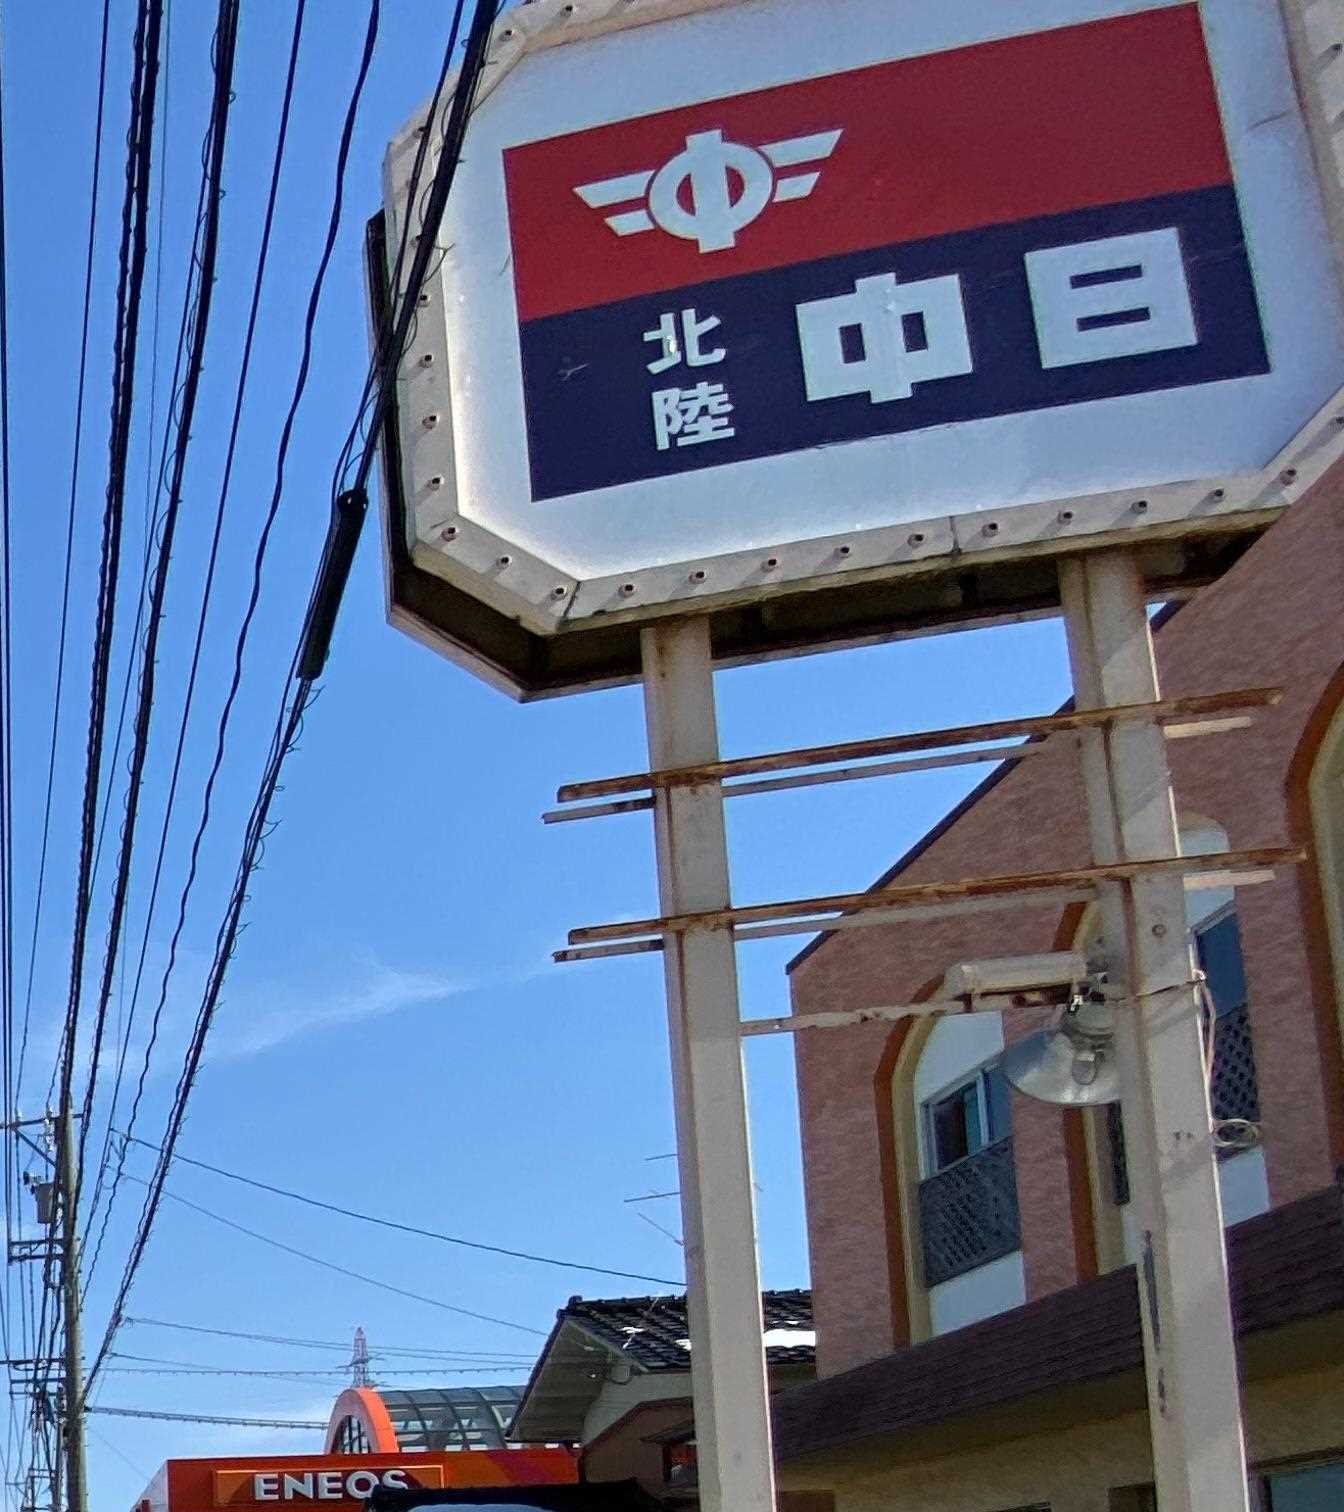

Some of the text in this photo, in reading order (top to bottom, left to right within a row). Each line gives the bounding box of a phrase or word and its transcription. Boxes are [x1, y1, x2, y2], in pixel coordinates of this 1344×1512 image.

[643, 226, 1200, 451] 北陸 中日
[254, 1470, 409, 1500] ENEOS
